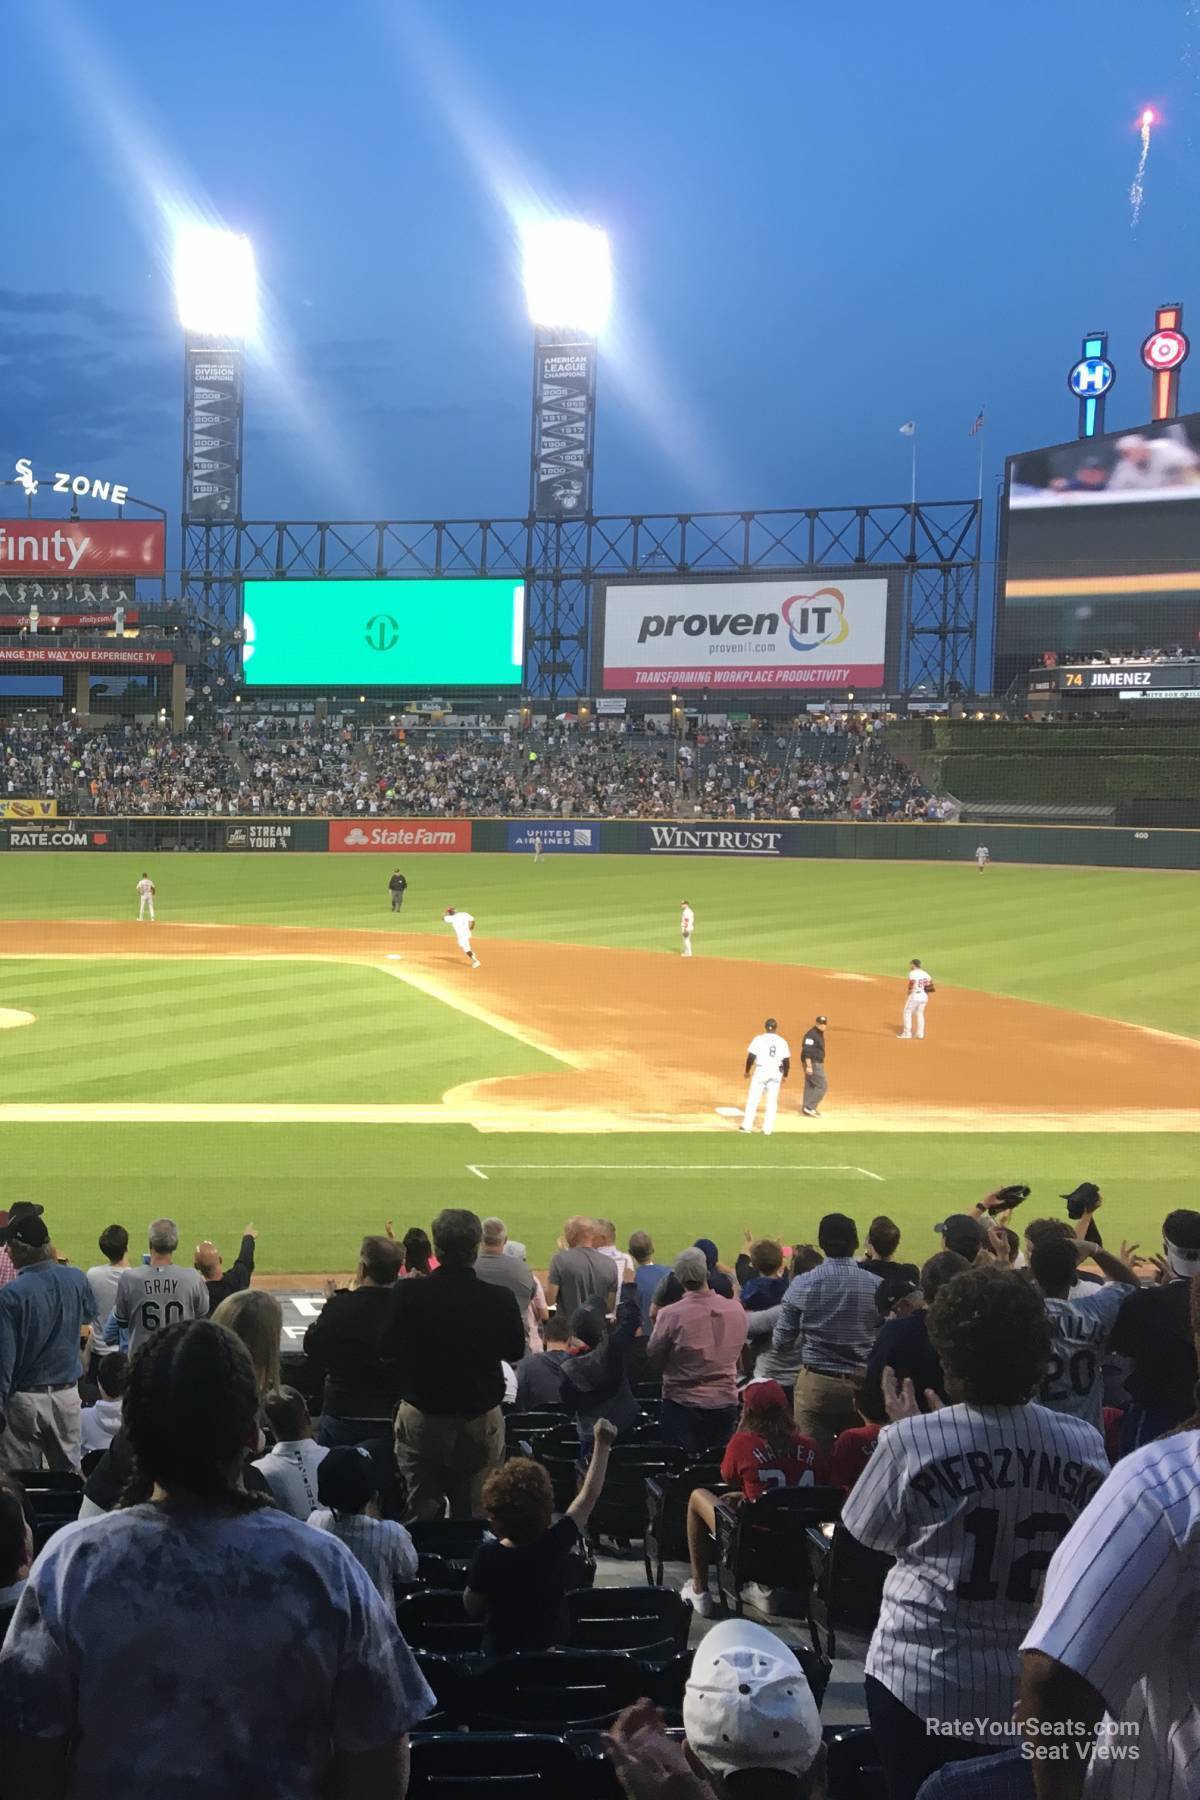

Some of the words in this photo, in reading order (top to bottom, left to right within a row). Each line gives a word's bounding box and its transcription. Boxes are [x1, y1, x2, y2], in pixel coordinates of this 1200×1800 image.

[544, 356, 587, 364] AMERICAN
[195, 368, 233, 376] DIVISION
[544, 364, 586, 372] LEAGUE
[1080, 365, 1104, 389] H
[53, 472, 129, 505] ZONE
[637, 612, 780, 644] proven
[800, 607, 832, 634] IT
[27, 650, 45, 659] THE
[48, 651, 68, 659] WAY
[70, 651, 89, 660] YOU
[91, 652, 144, 661] EXPERIENCE
[146, 653, 156, 661] TV
[635, 670, 712, 683] TRANSFORMING
[714, 670, 774, 682] WORKPLACE
[775, 669, 850, 682] PRODUCTIVITY
[1066, 674, 1083, 686] 74
[1090, 672, 1152, 686] JIMENEZ
[250, 826, 291, 837] STREAM
[650, 826, 781, 849] WINTRUST
[10, 834, 88, 846] RATE.COM
[250, 838, 276, 848] YOUR
[515, 836, 571, 845] AIRINES
[144, 1279, 178, 1295] GRAY
[910, 1447, 1105, 1510] PIERZYNSK
